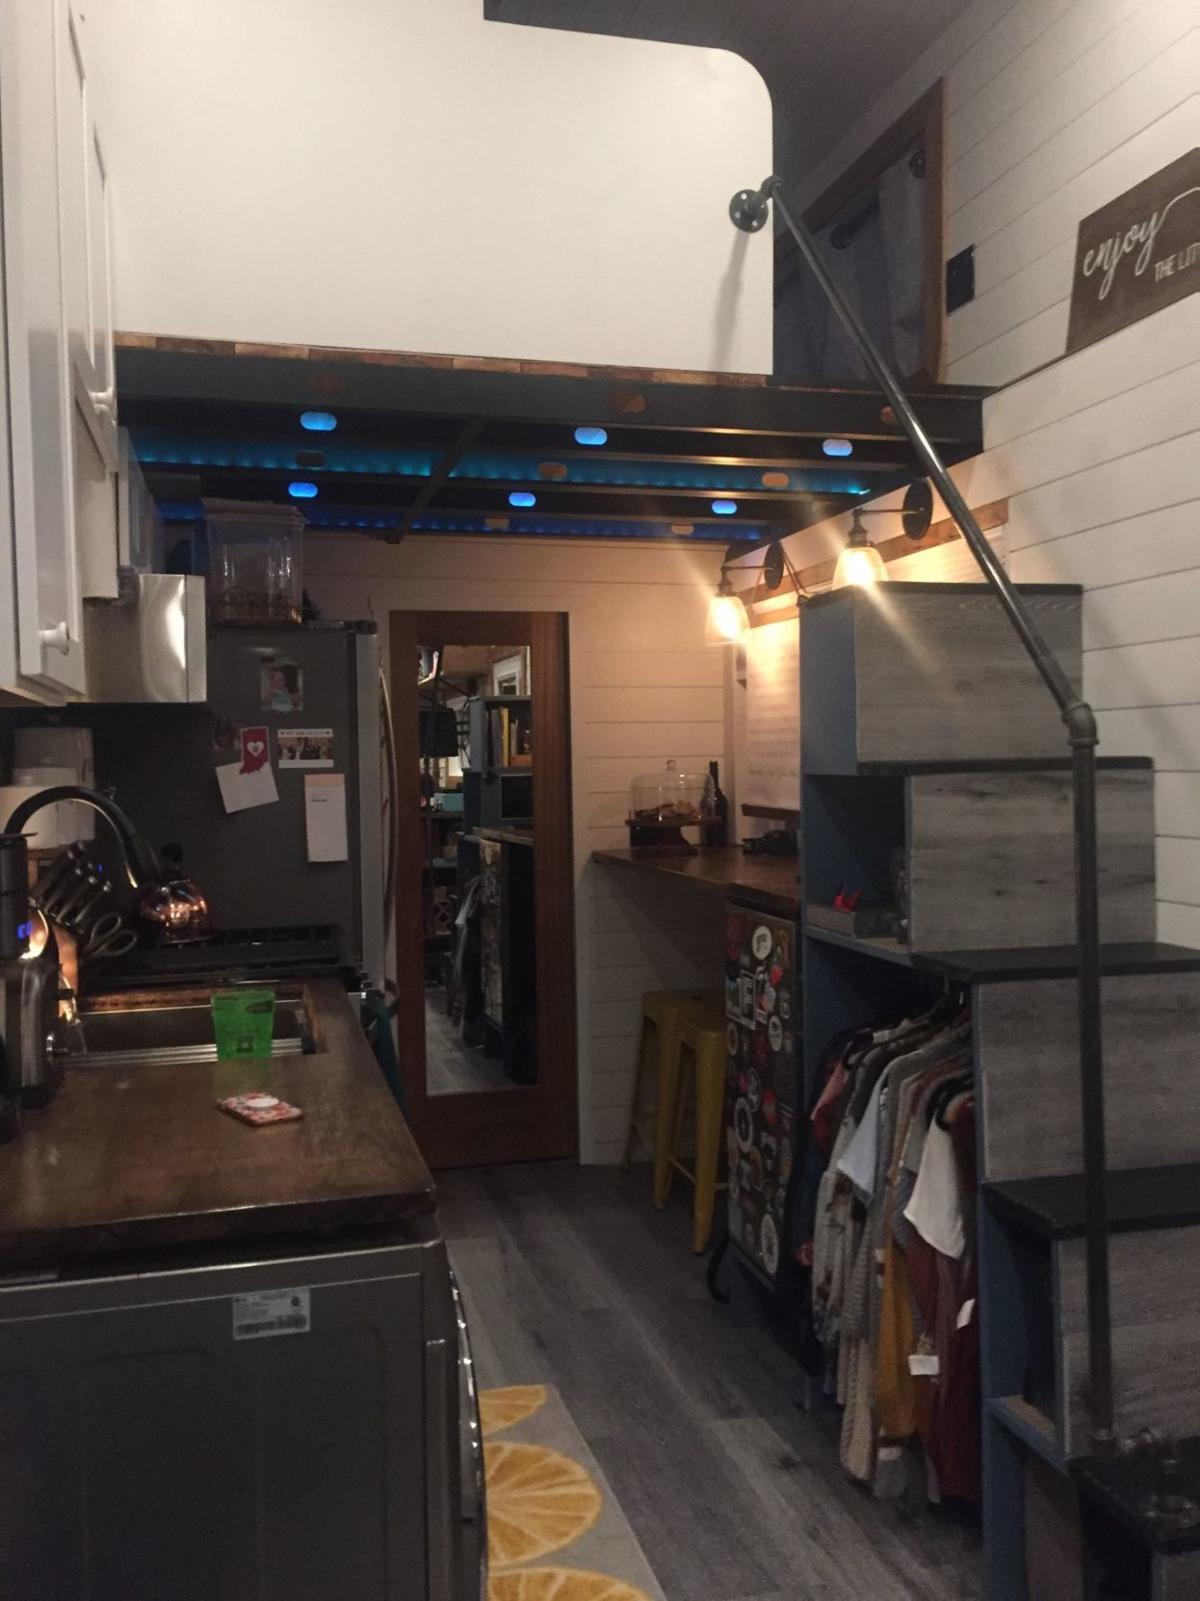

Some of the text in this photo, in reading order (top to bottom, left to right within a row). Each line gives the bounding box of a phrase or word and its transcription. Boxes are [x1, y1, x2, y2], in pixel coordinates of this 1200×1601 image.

[1083, 204, 1167, 301] enjoy
[1154, 242, 1200, 282] THE LIT
